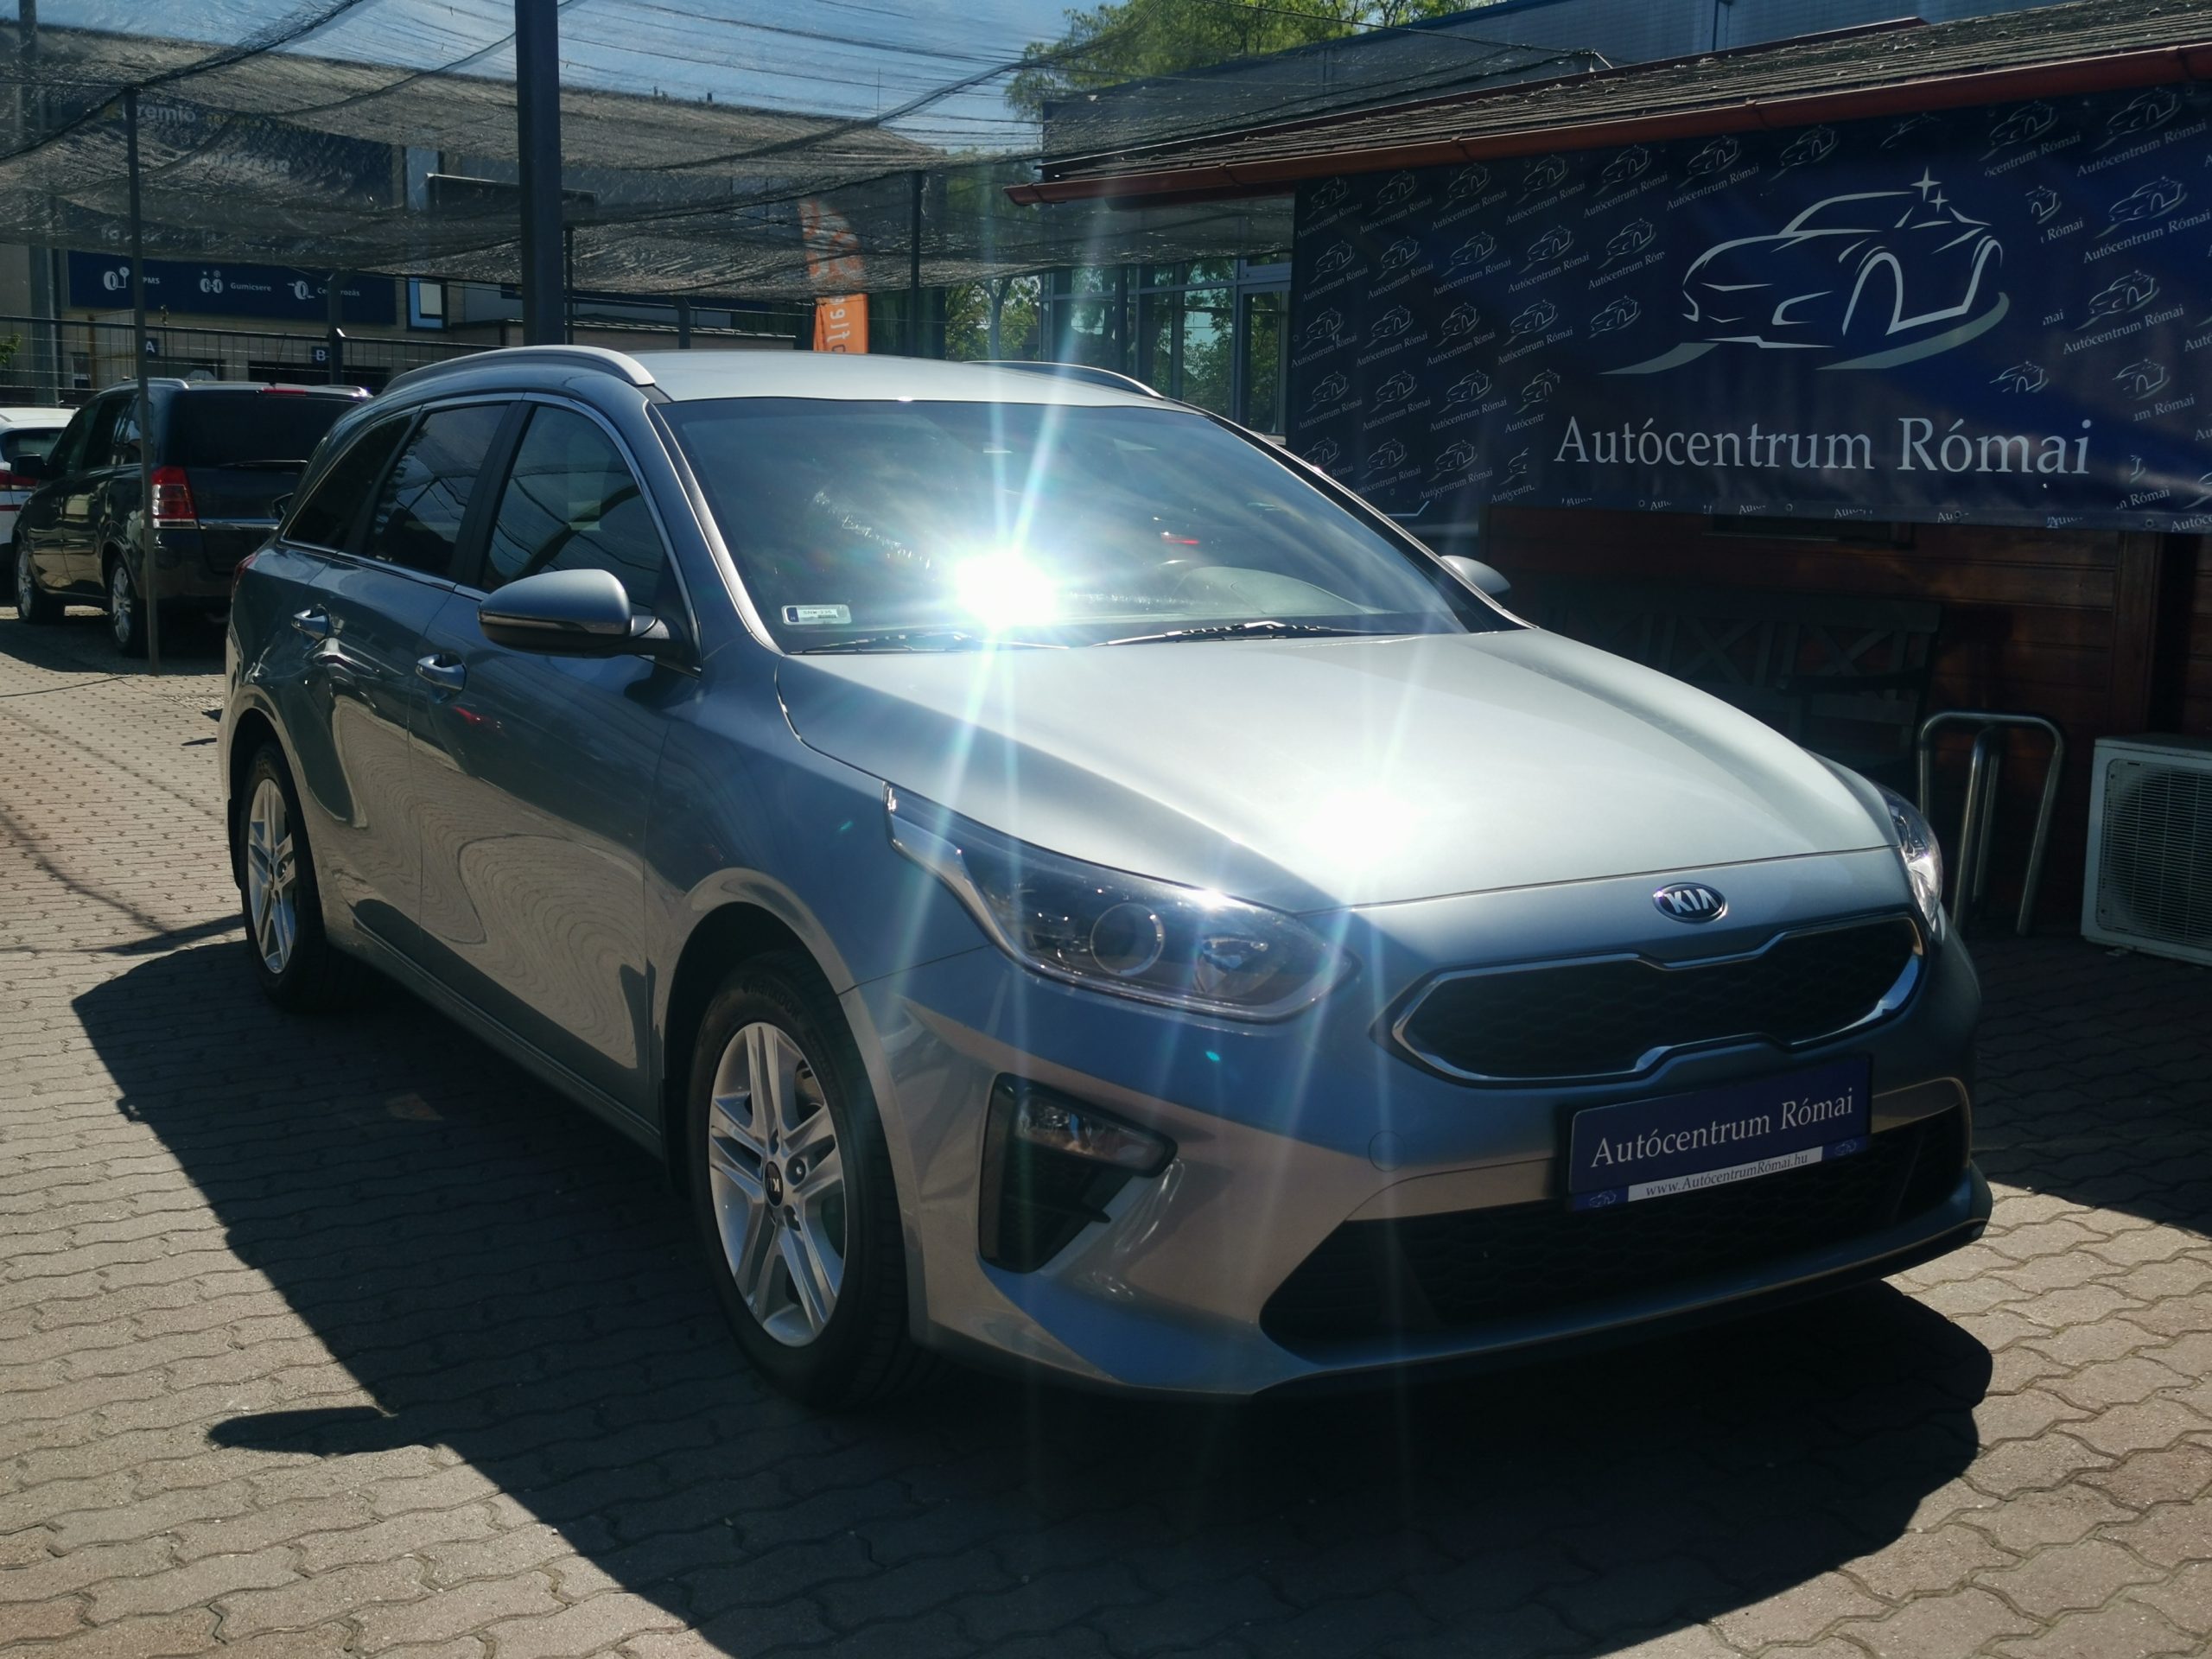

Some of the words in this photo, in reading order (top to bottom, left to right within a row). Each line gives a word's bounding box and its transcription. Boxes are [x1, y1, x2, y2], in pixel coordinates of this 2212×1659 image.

[2040, 131, 2081, 155] Római
[2076, 138, 2160, 177] Autócentrum
[2164, 118, 2208, 143] Római
[1506, 195, 1558, 226] Autócentrum
[1560, 181, 1586, 200] Római
[1583, 188, 1639, 219] Autócentrum
[1641, 172, 1669, 192] Római
[1666, 178, 1727, 212] Autócentrum
[1729, 162, 1759, 182] Római
[2047, 217, 2084, 242] Római
[2082, 227, 2164, 264] Autócentrum
[2168, 208, 2210, 234] Római
[1484, 257, 1511, 275] Római
[1508, 266, 1561, 294] Autócentrum
[1563, 251, 1590, 270] Római
[1587, 259, 1642, 289] Autócentrum
[230, 282, 272, 292] Gumicsere
[1497, 340, 1544, 365] Autócentrum
[1546, 326, 1574, 344] Római
[2063, 321, 2141, 355] Autócentrum
[2145, 304, 2184, 327] Római
[316, 349, 326, 361] B
[2155, 394, 2196, 415] Római
[1553, 416, 1875, 469] Autócentrum
[1897, 416, 2091, 475] Római
[2130, 487, 2171, 506] Római
[1664, 888, 1719, 913] KIA
[1590, 1115, 1770, 1167] Autócentrum
[1780, 1088, 1853, 1130] Római
[1646, 1153, 1808, 1198] www.AutócentrumRómai.hu
